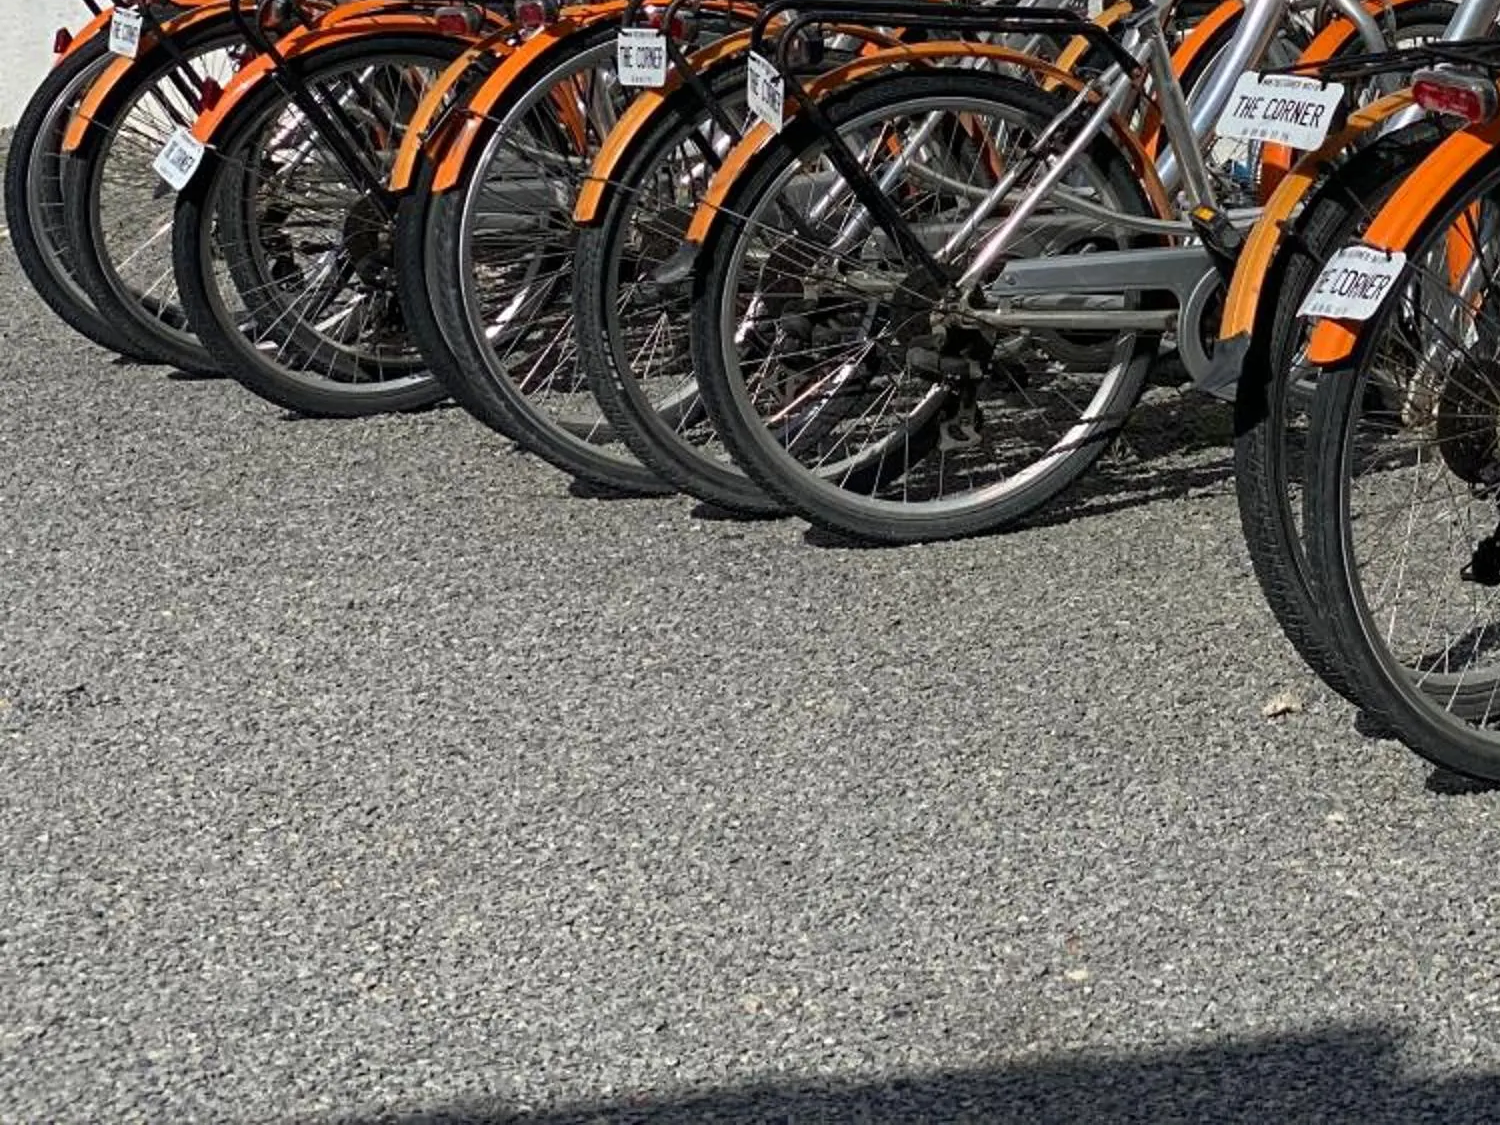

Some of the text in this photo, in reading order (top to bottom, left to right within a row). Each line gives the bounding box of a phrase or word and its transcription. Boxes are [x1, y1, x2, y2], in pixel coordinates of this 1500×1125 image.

[1233, 95, 1325, 128] THE CORNER
[1330, 268, 1391, 300] CORNER
